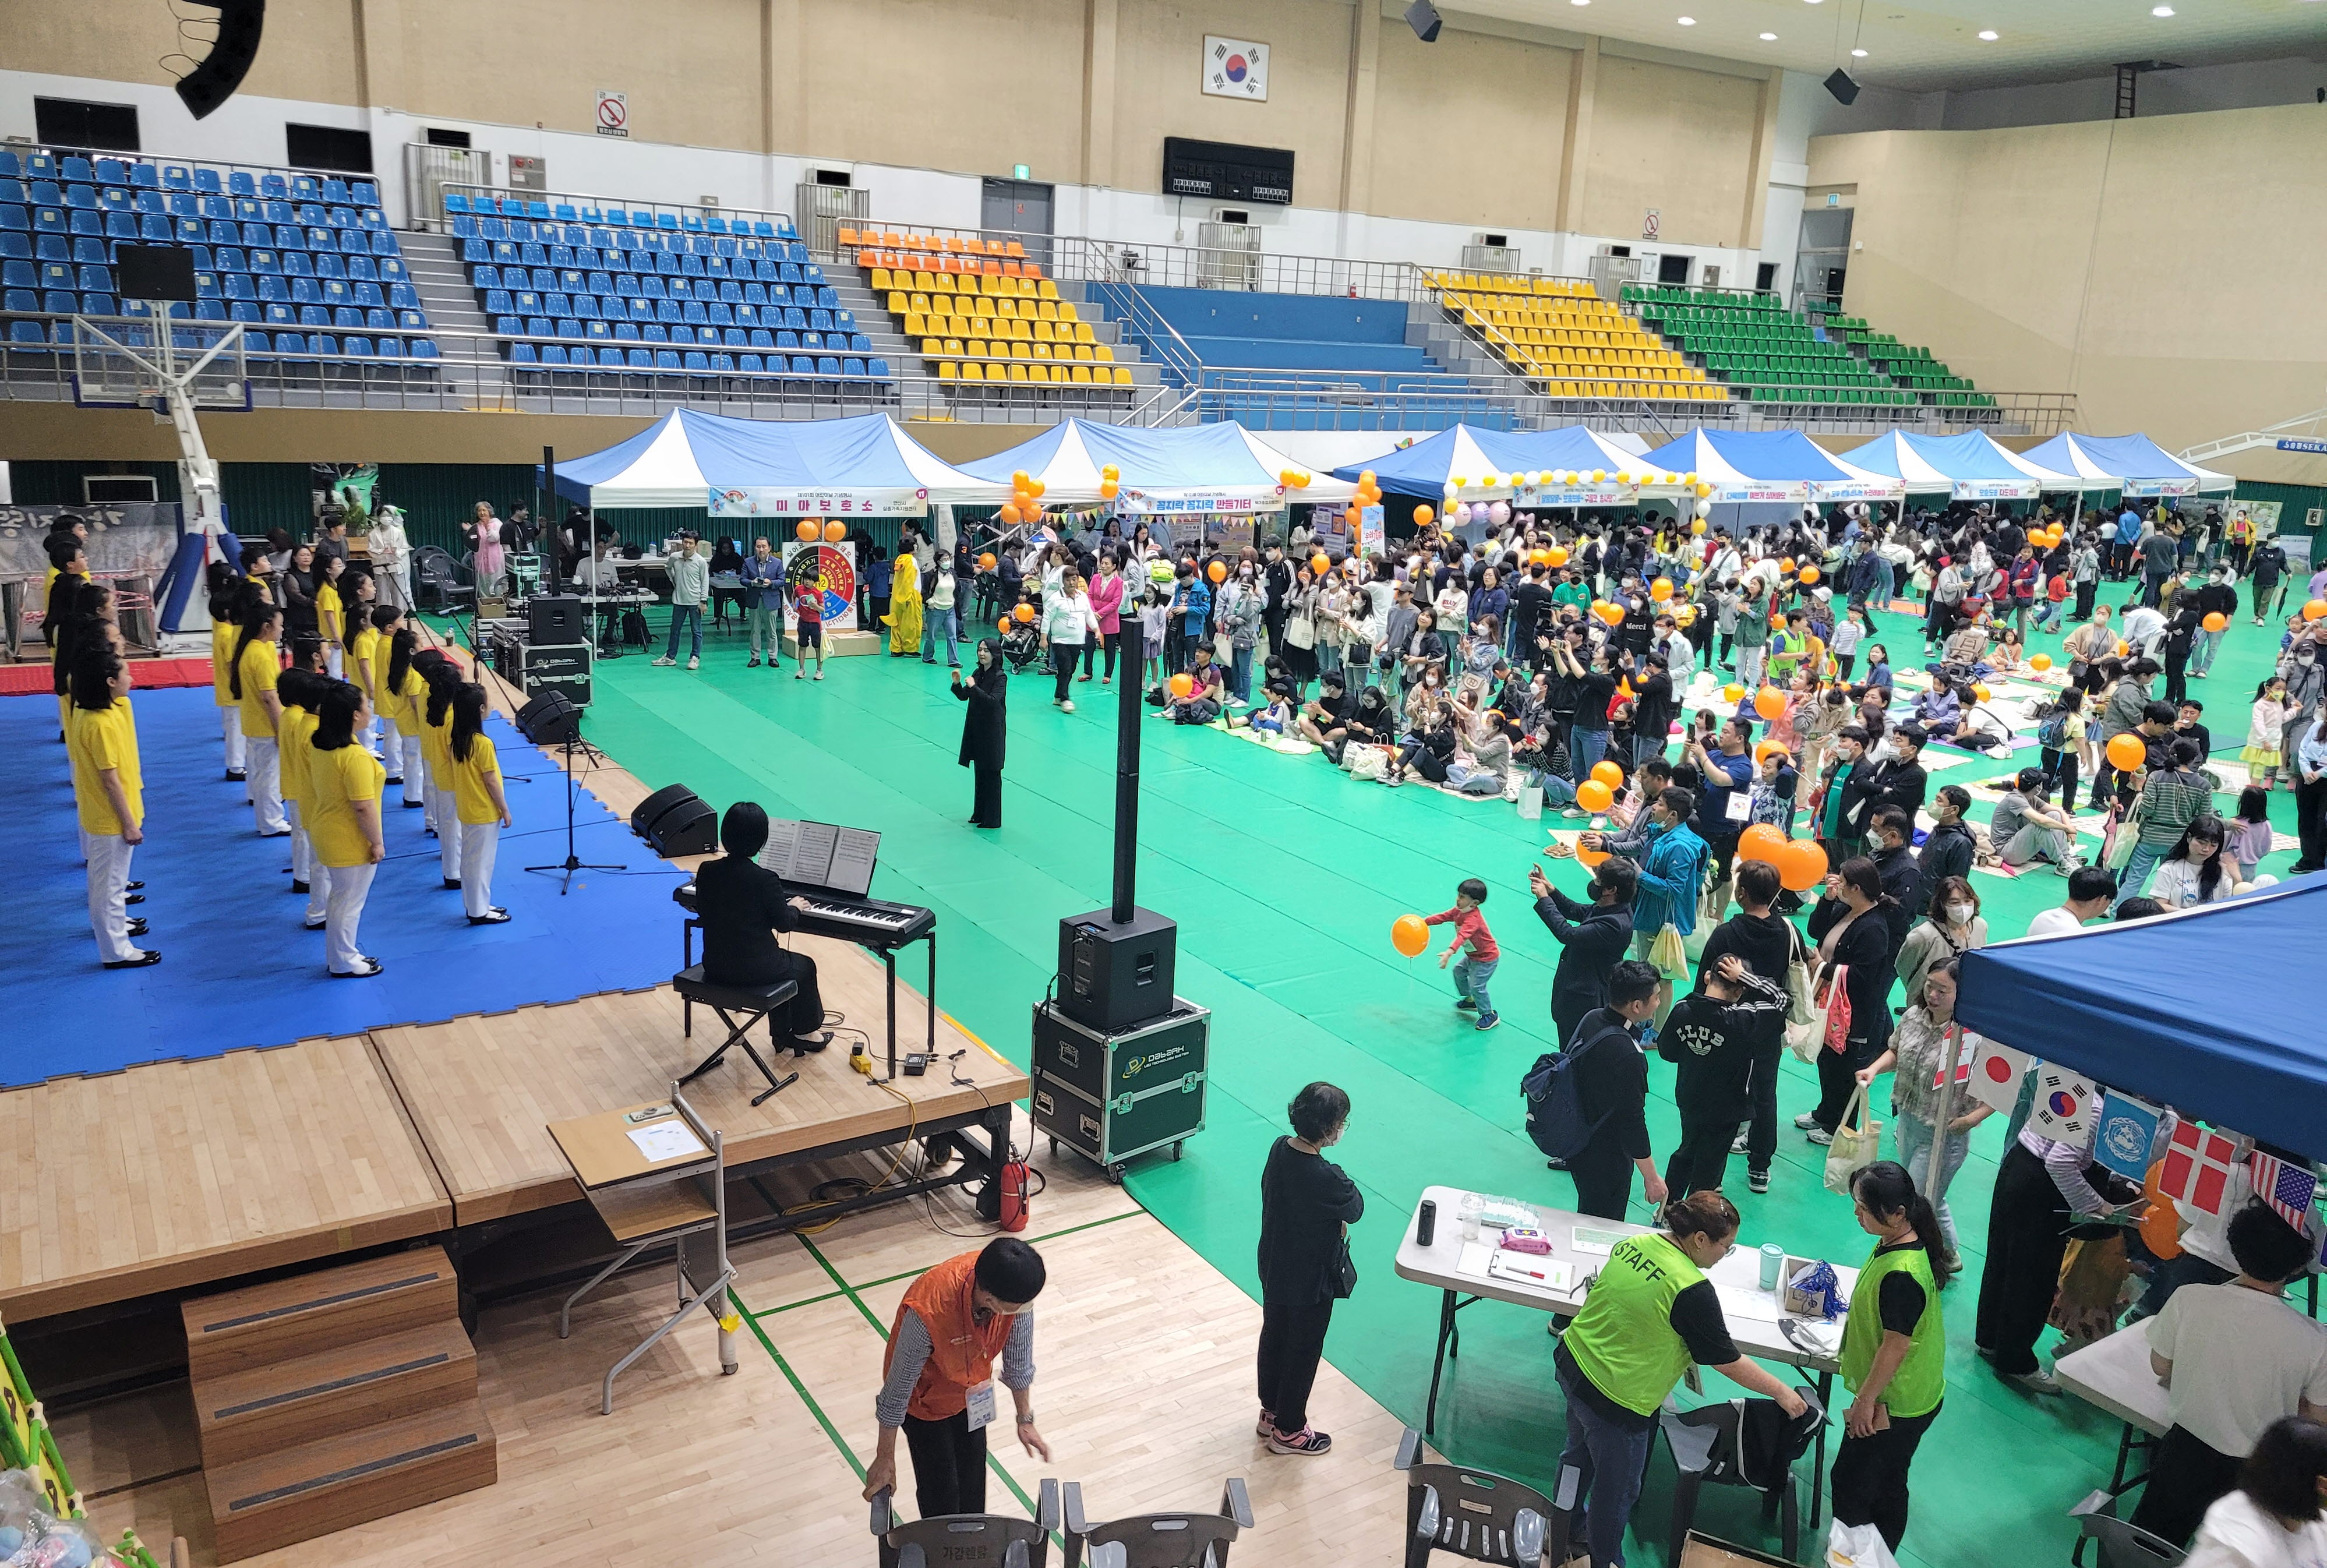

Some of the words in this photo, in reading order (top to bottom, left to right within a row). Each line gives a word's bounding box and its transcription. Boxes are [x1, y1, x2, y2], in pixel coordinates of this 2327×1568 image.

[1157, 500, 1185, 510] 꼼지락
[1187, 500, 1214, 510] 꼼지락
[1216, 499, 1251, 510] 만들기터
[961, 546, 967, 554] 3
[1626, 622, 1647, 631] Merci
[1676, 1025, 1725, 1047] CLUB
[1614, 1242, 1667, 1281] STAFF
